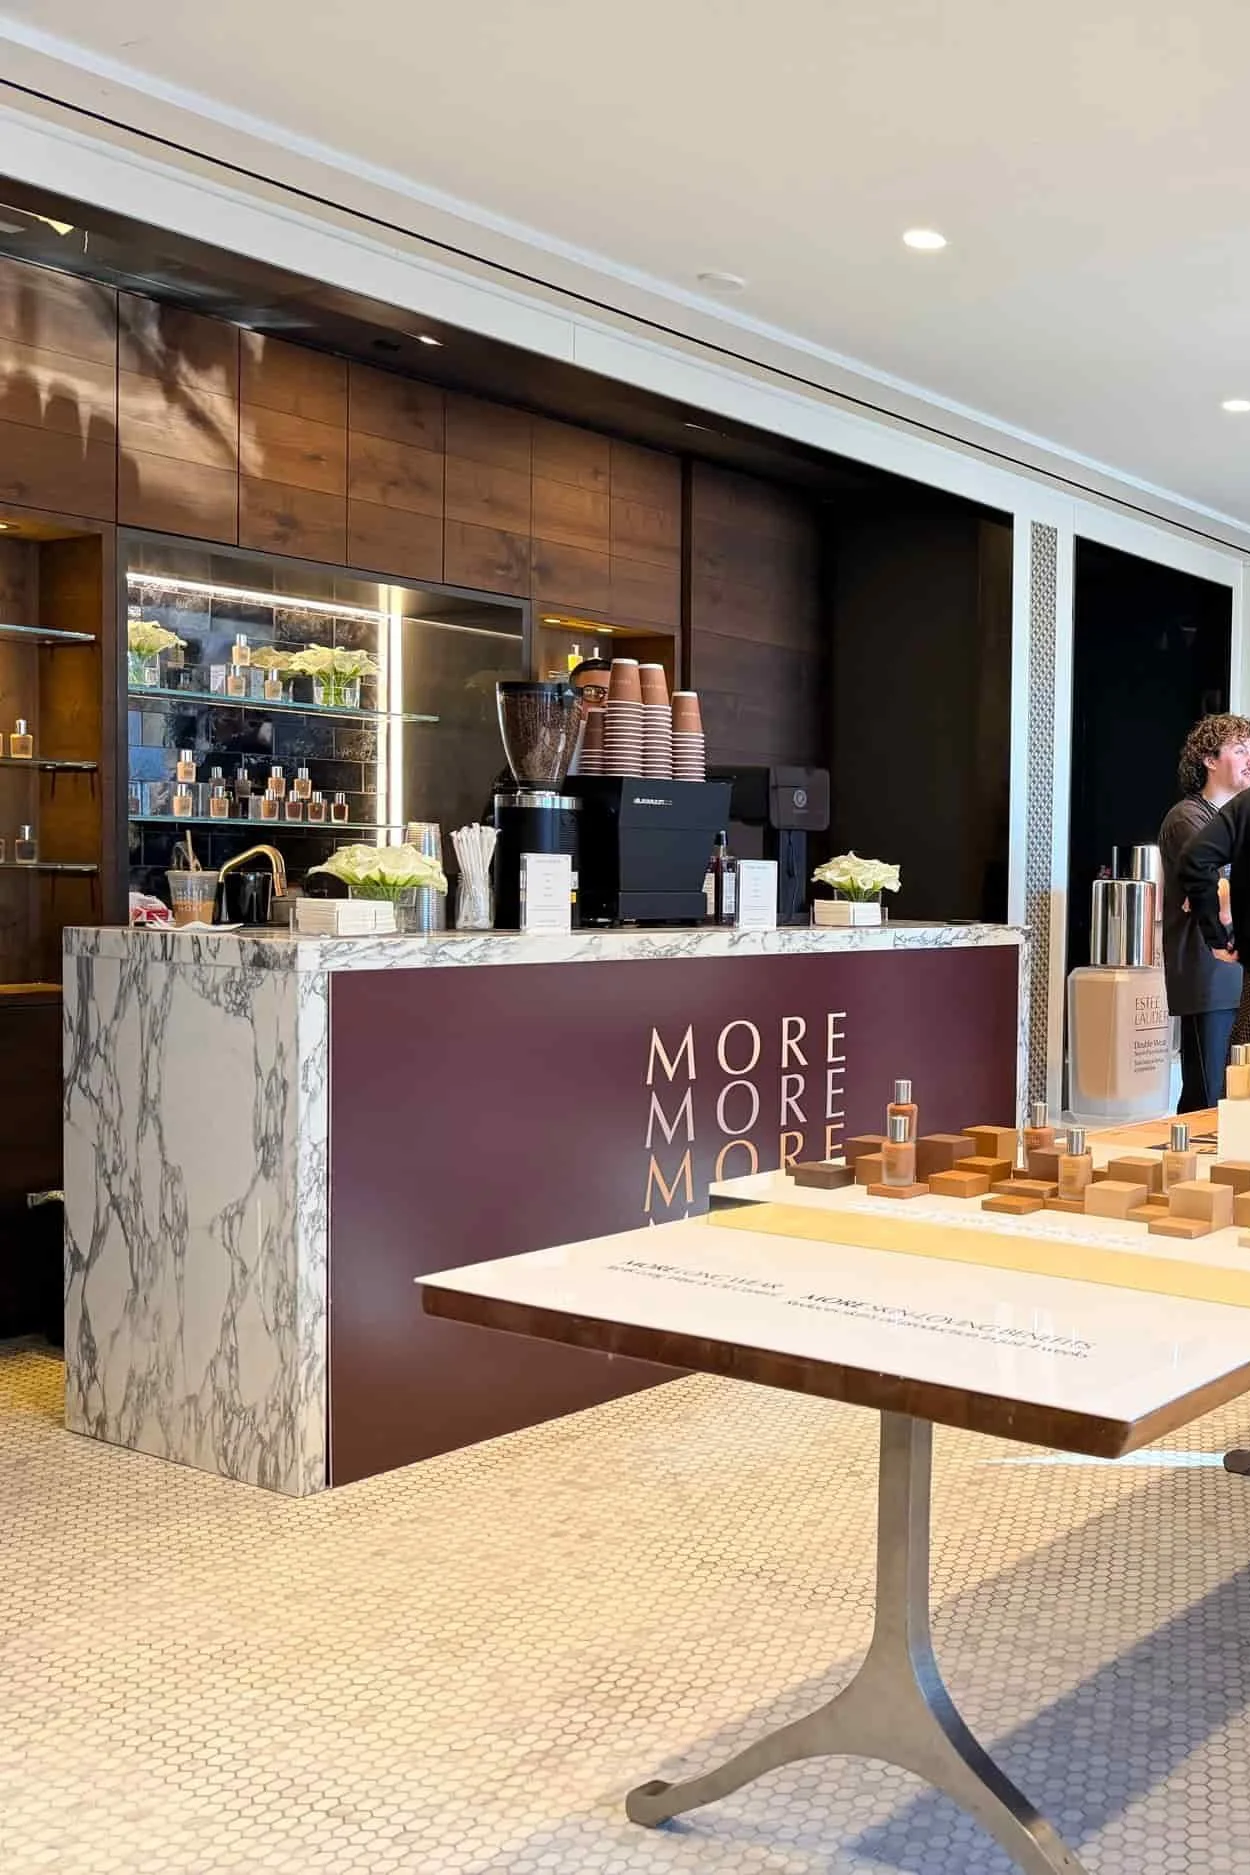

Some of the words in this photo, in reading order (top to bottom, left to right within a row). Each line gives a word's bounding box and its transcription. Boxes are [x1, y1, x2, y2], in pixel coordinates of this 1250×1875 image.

[645, 1011, 847, 1085] MORE
[645, 1067, 846, 1149] MORE
[799, 1292, 872, 1309] MORE
